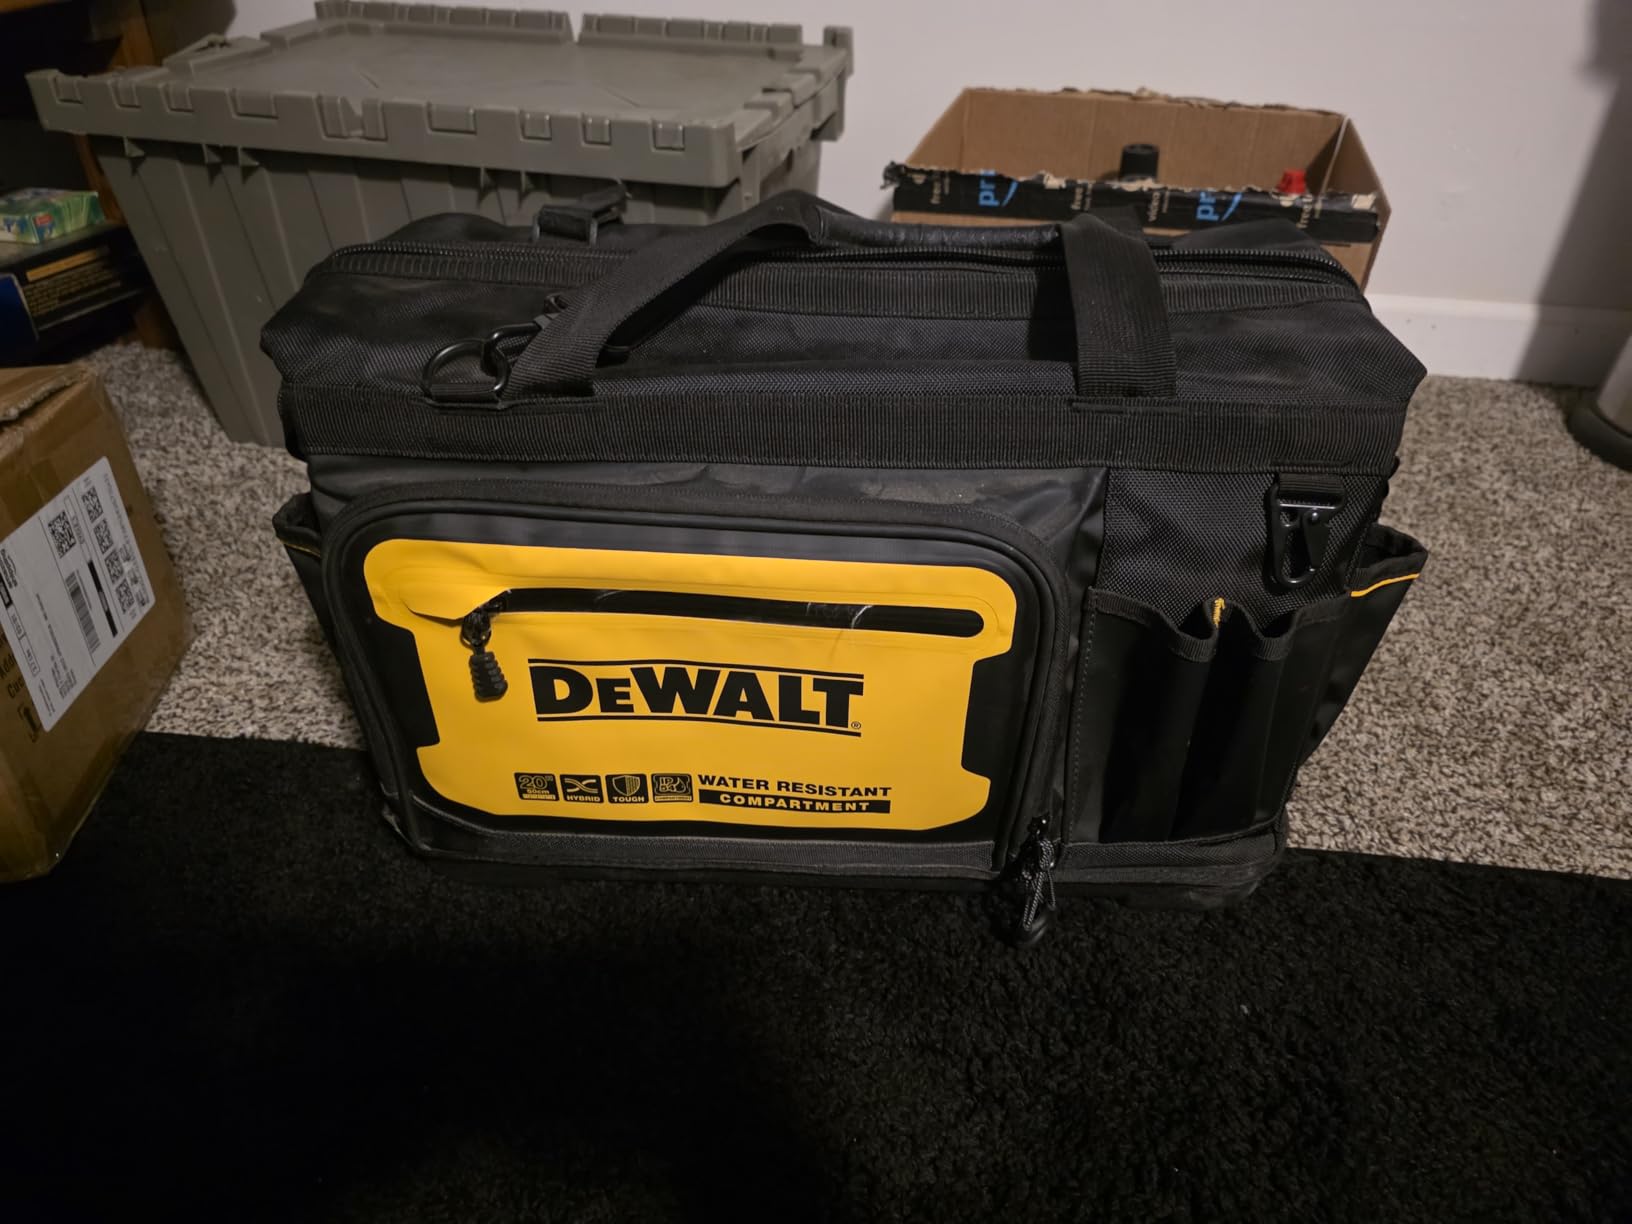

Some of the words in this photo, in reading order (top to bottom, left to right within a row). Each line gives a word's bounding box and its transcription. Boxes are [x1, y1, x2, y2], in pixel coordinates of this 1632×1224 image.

[697, 774, 770, 791] WATER
[777, 780, 892, 797] RESISTANT
[566, 795, 601, 803] HYBRID
[612, 795, 645, 803] TOUGH
[719, 793, 871, 812] COMPARTMENT
